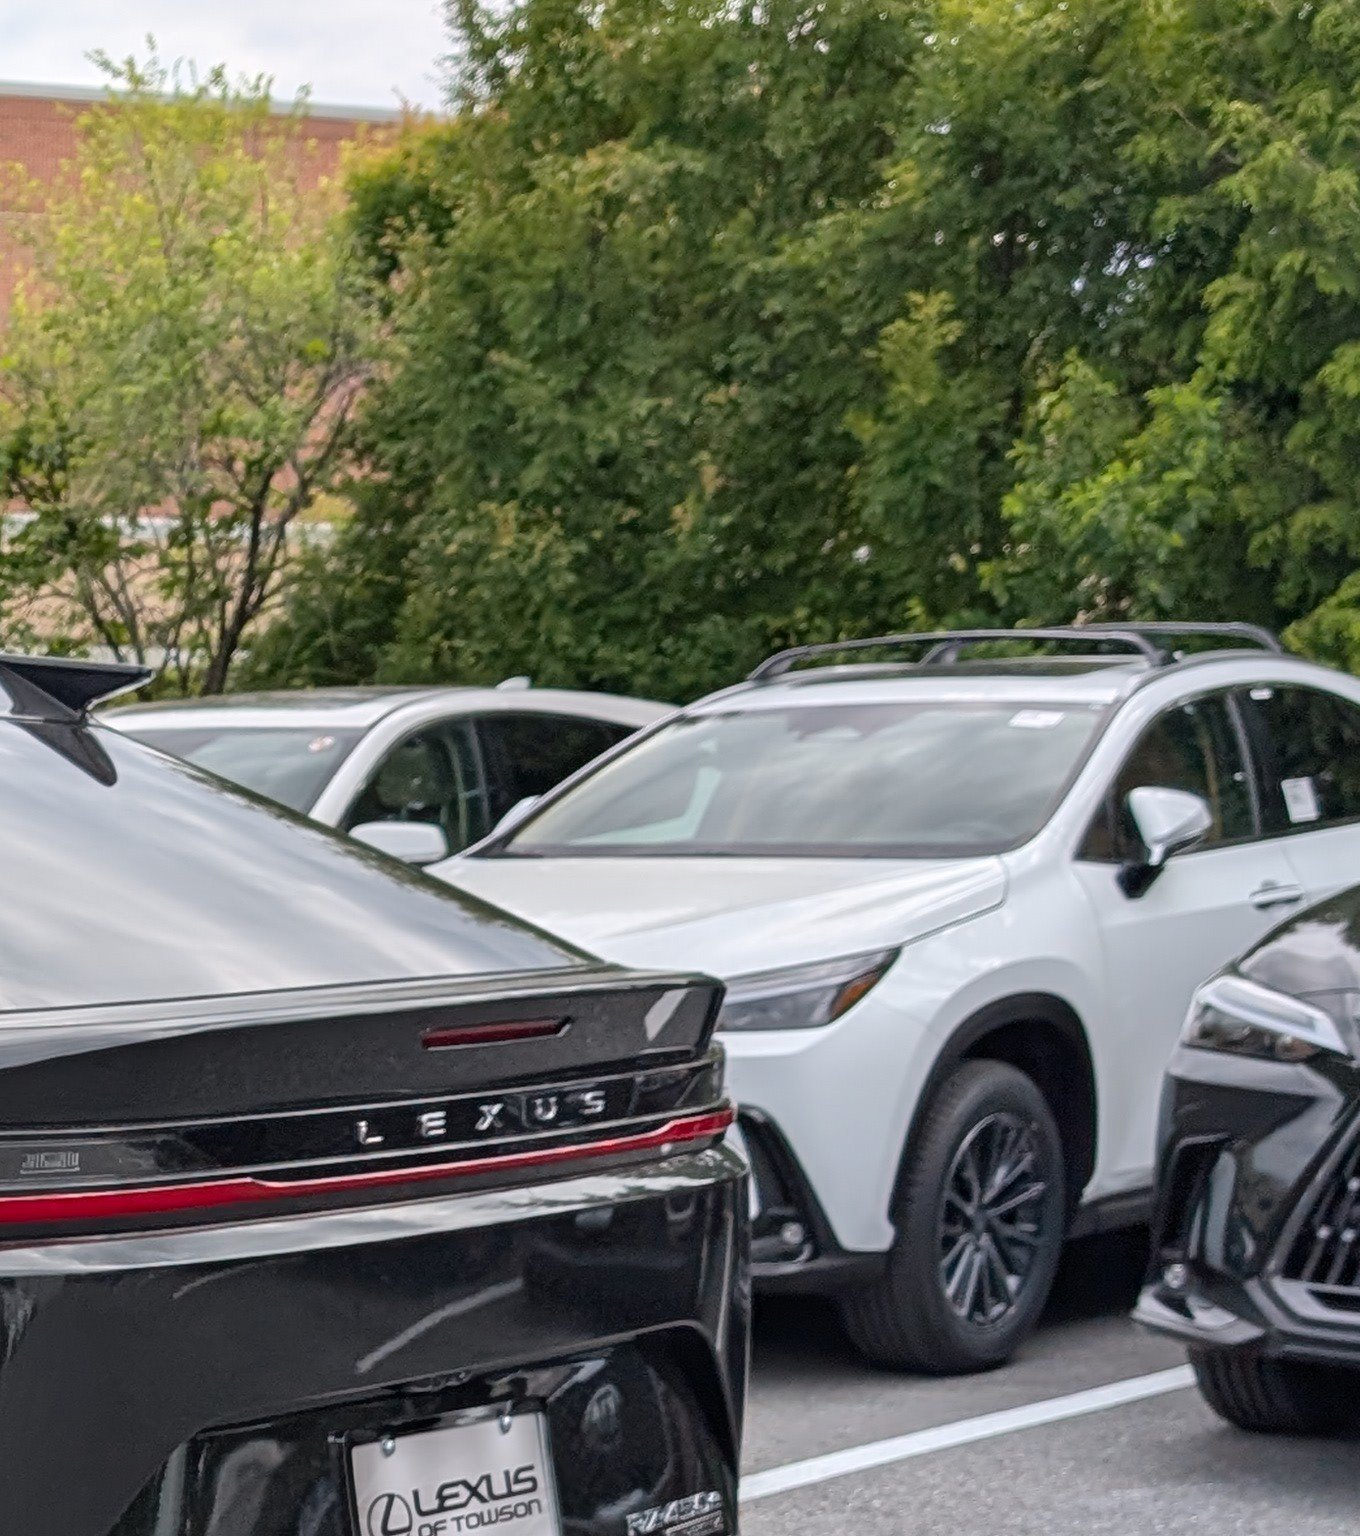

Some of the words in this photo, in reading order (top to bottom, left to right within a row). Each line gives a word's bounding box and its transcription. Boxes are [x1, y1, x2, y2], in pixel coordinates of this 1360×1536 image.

[356, 1090, 606, 1145] LEXUS
[412, 1464, 538, 1517] LEXUS
[451, 1498, 543, 1532] TOWSON
